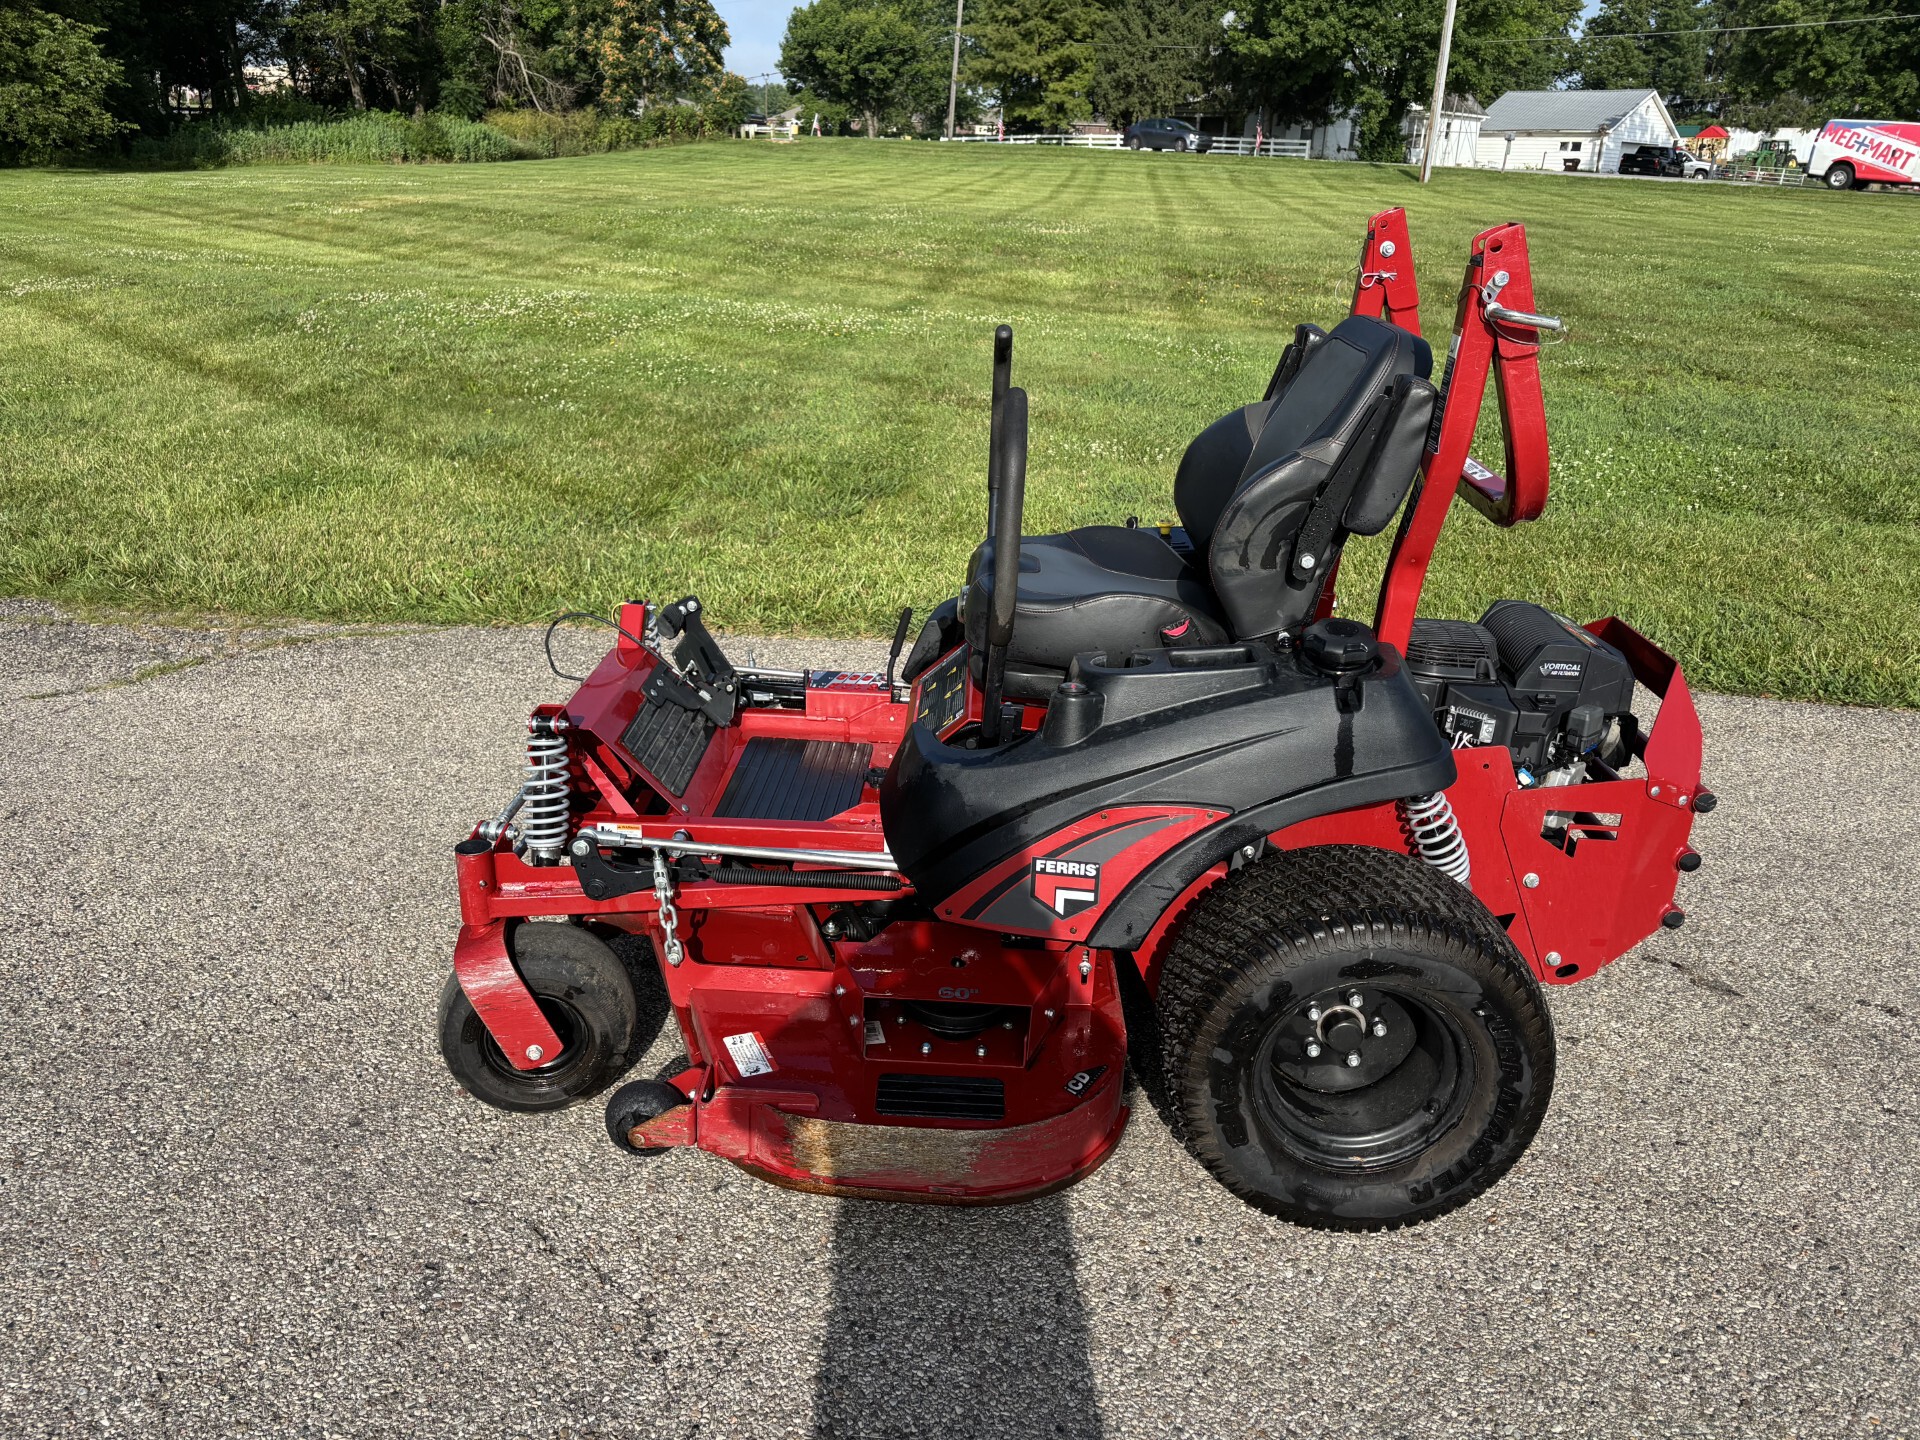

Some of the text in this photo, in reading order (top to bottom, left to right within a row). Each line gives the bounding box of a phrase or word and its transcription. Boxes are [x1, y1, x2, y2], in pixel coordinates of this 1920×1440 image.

[1544, 662, 1581, 671] VORTICAL
[1035, 859, 1097, 876] FERRIS
[1408, 1085, 1524, 1205] MASTER
